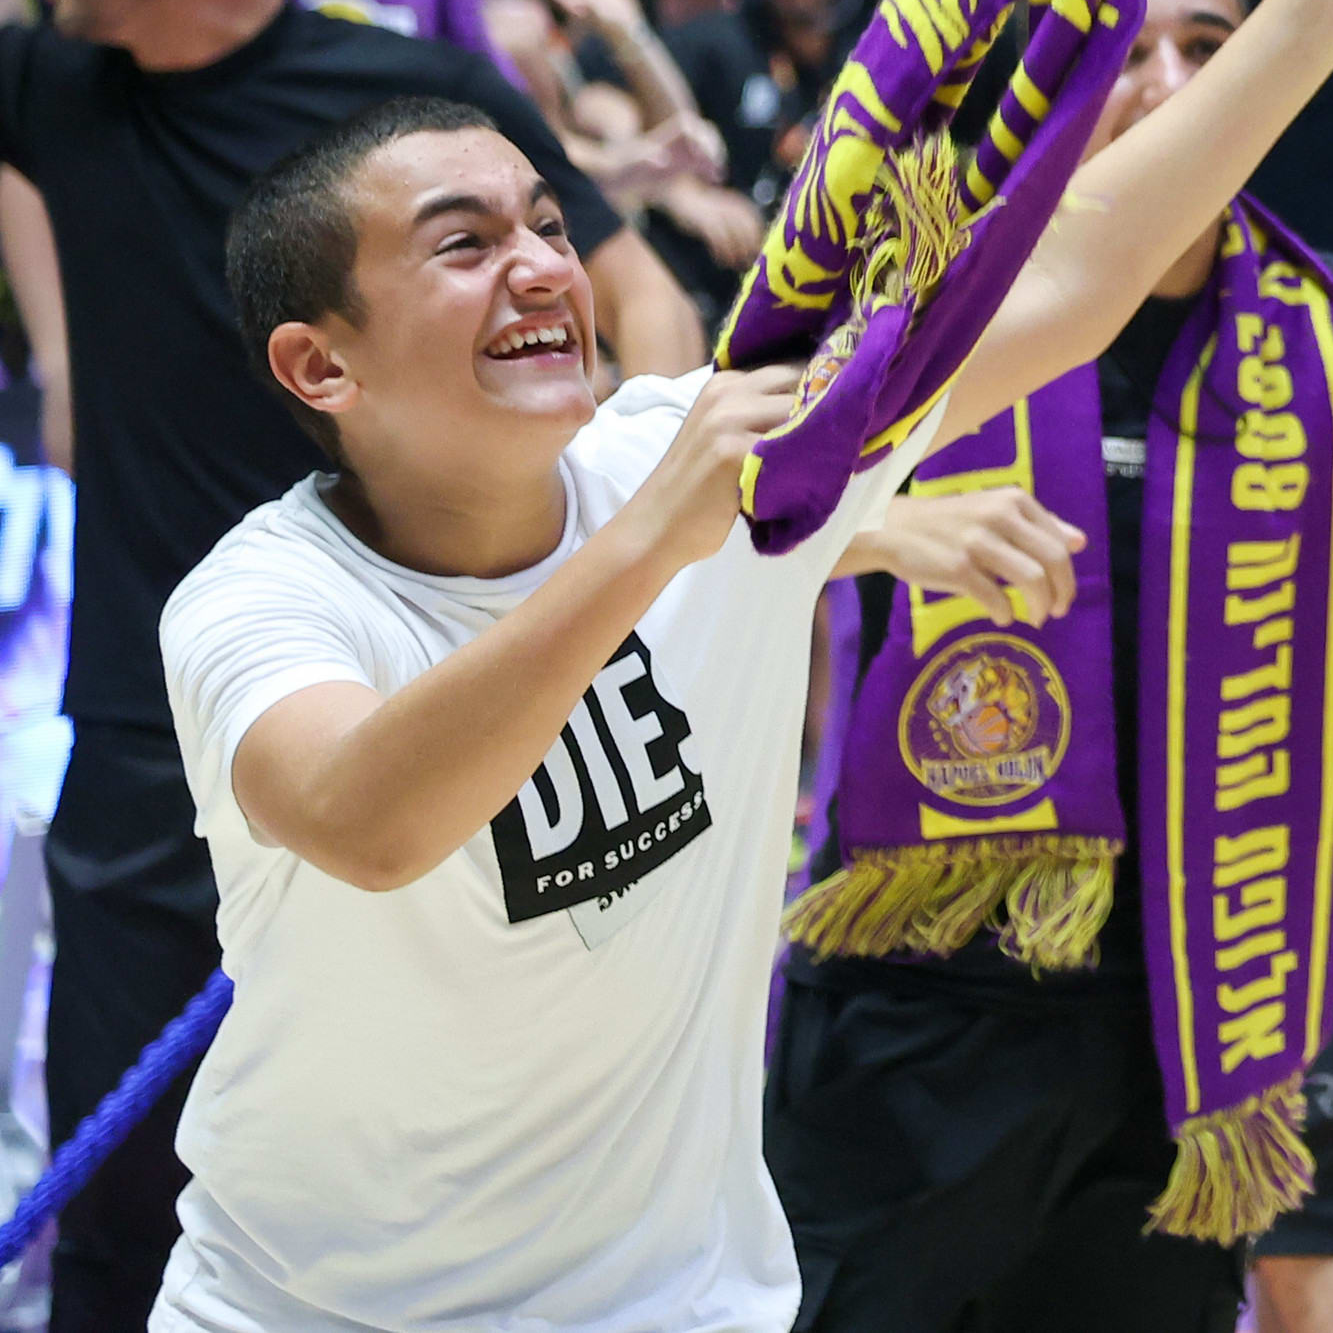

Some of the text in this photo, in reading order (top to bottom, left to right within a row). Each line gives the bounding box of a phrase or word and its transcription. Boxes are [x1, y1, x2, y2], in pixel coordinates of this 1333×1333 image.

[1232, 314, 1309, 511] 2008
[517, 650, 692, 862] DIE
[1215, 535, 1299, 811] המדינה
[536, 861, 596, 895] FOR
[1214, 823, 1297, 1073] אלופת
